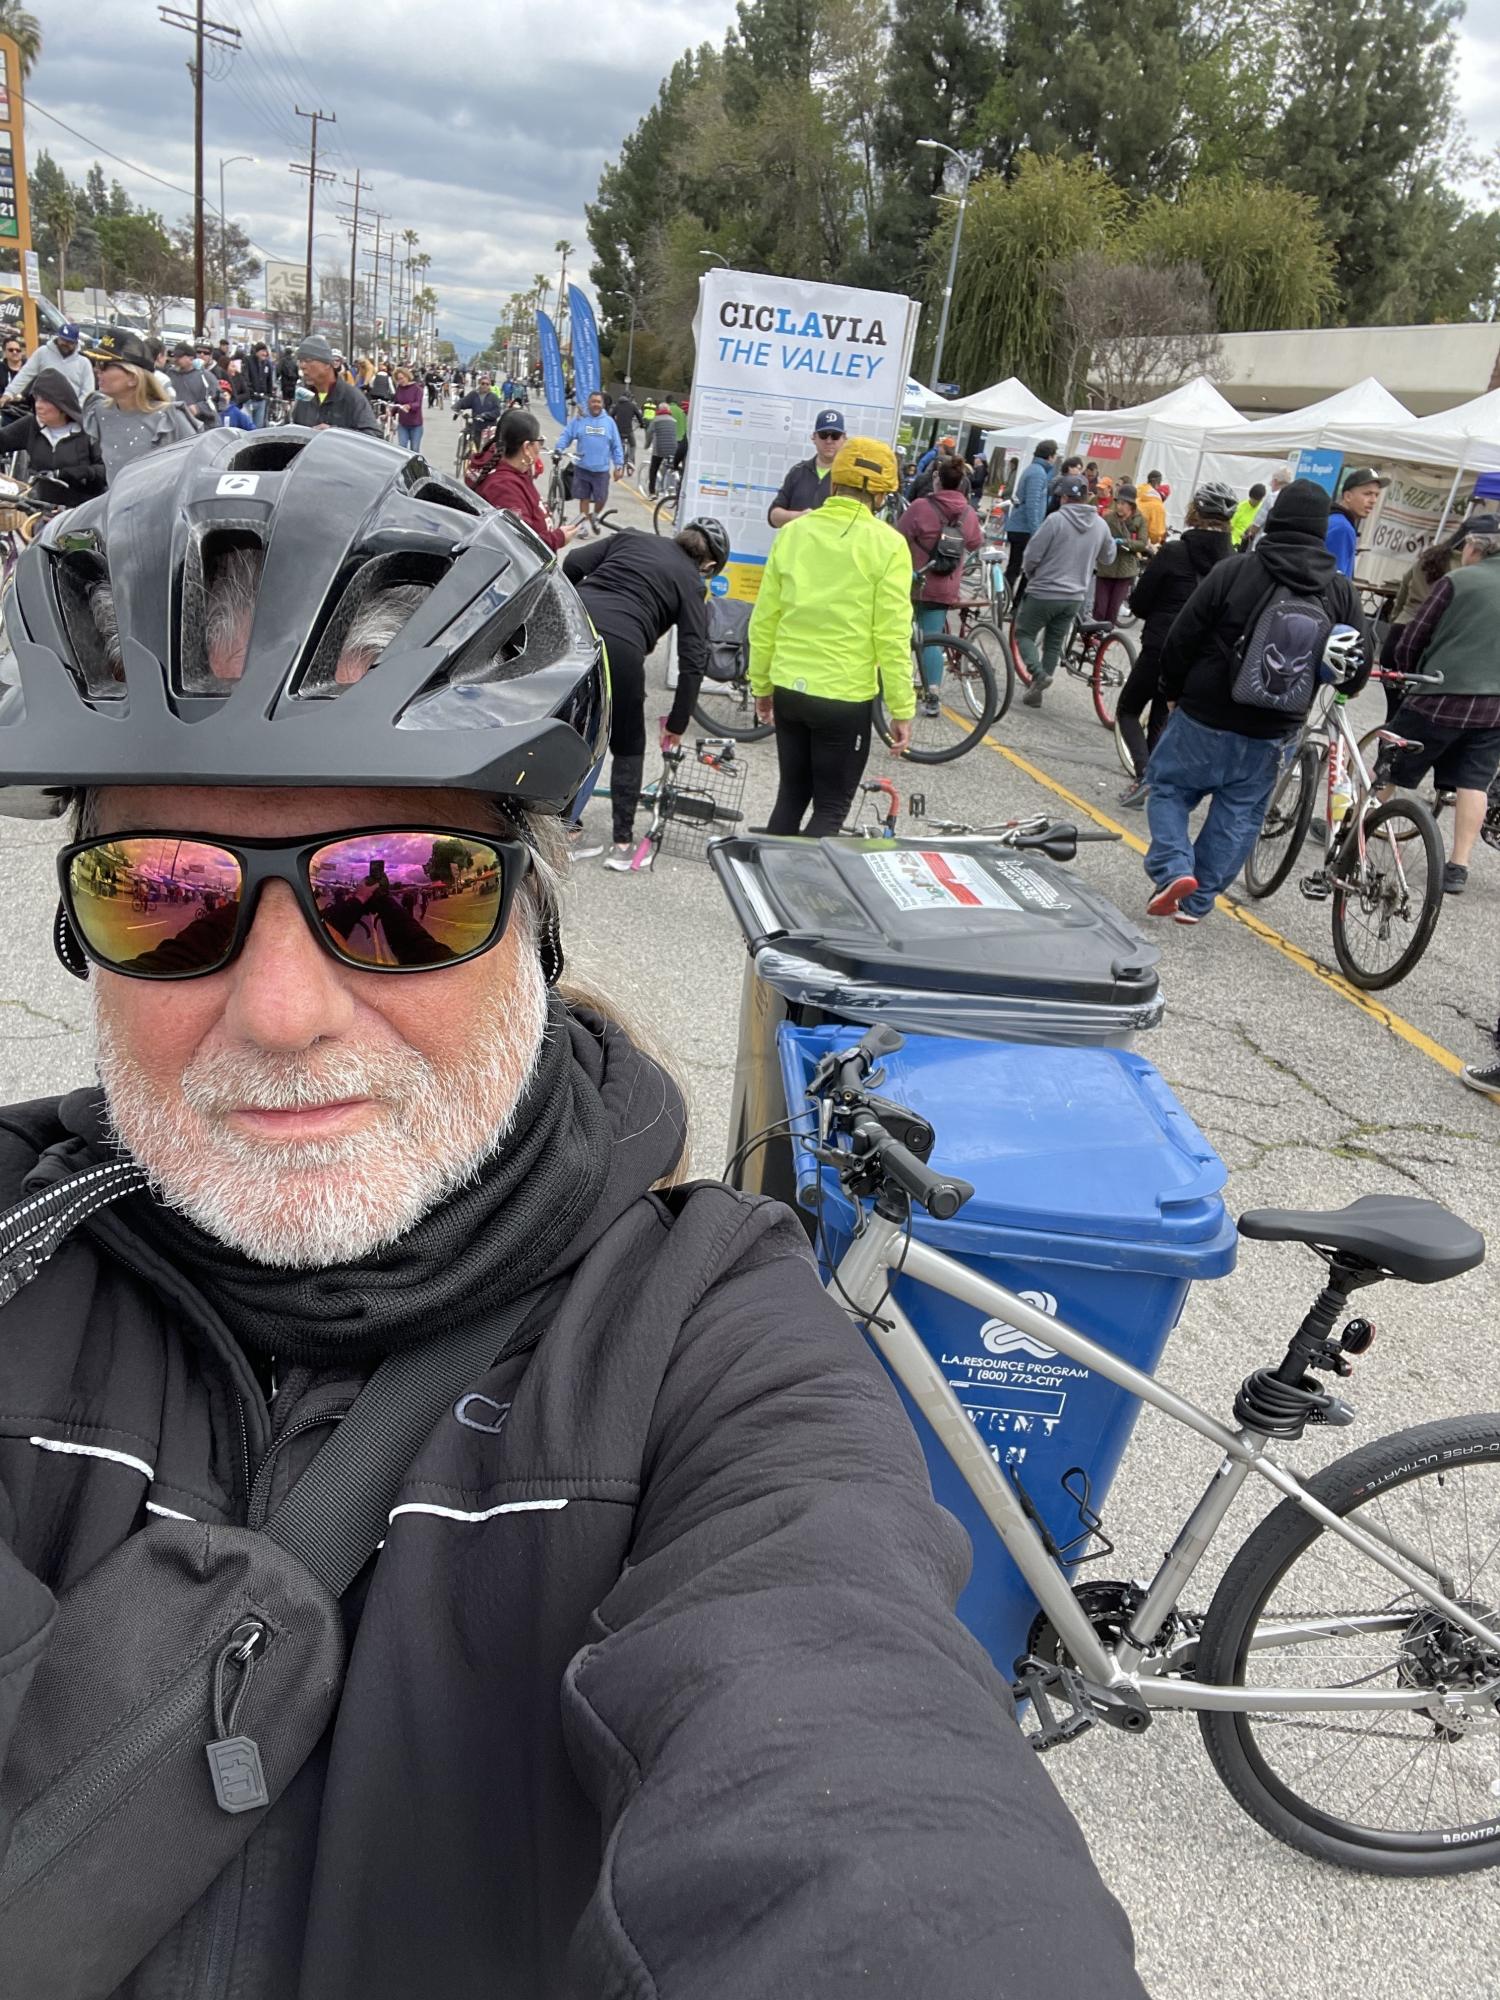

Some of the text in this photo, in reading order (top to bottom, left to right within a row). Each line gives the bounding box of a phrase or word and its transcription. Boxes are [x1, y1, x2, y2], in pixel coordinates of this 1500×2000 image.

[719, 301, 887, 346] CICLAVIA
[719, 337, 885, 379] THE VALLEY
[967, 1368, 1063, 1387] 1 (800) 773-CITY
[1027, 1360, 1089, 1378] PROGRAM
[966, 1410, 1060, 1437] VENT
[1366, 1454, 1438, 1490] ULTIMATE
